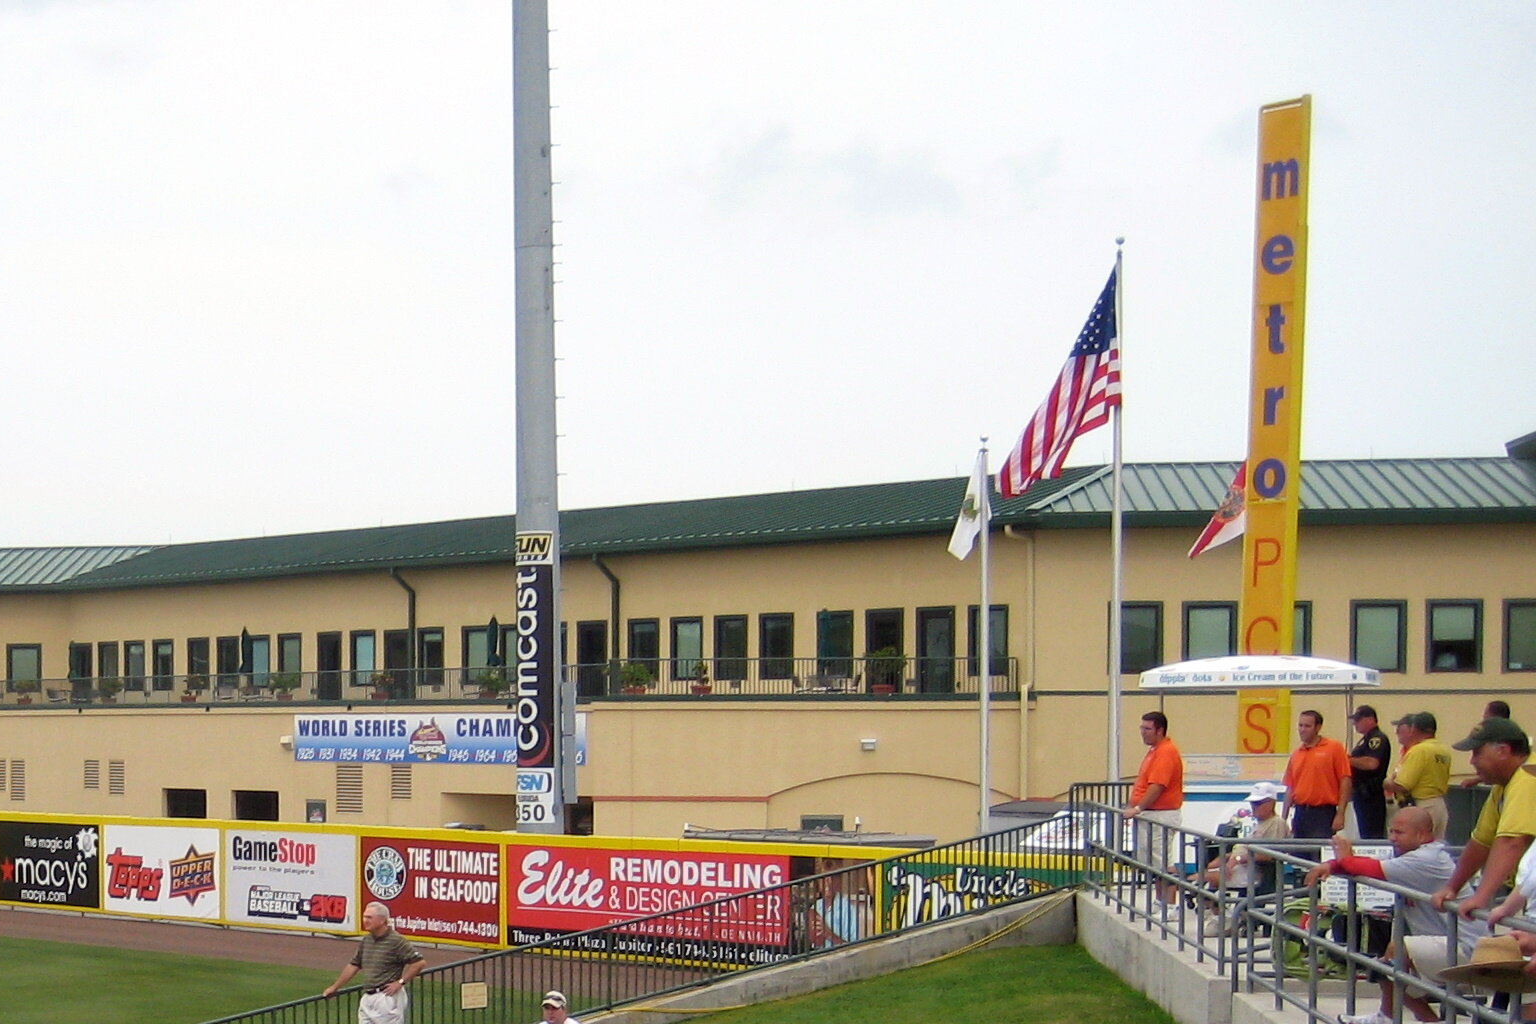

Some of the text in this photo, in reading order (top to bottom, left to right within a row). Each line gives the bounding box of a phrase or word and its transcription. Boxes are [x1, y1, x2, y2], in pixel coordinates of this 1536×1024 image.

[1252, 158, 1300, 499] metro
[517, 569, 539, 751] comcast
[1247, 672, 1276, 682] Cream
[297, 718, 407, 738] WORLD SERIES
[362, 748, 382, 761] 1942
[384, 748, 406, 761] 1944
[474, 749, 496, 762] 1964
[24, 835, 73, 853] the magic of
[232, 835, 316, 867] GameStop
[15, 853, 88, 895] macy's
[106, 846, 163, 902] Topps
[172, 859, 213, 878] UPPER
[283, 867, 315, 876] players
[407, 847, 498, 877] THE ULTIMATE
[609, 857, 782, 889] REMODELING
[414, 876, 498, 905] IN SEAFOOD!
[517, 849, 604, 909] Elite
[955, 866, 1029, 897] Uncle
[21, 889, 67, 903] macys.com
[249, 899, 299, 915] BASEBALL
[250, 890, 301, 902] MAJOR LEAGUE
[608, 885, 695, 913] & DESIGN
[512, 929, 541, 945] Three
